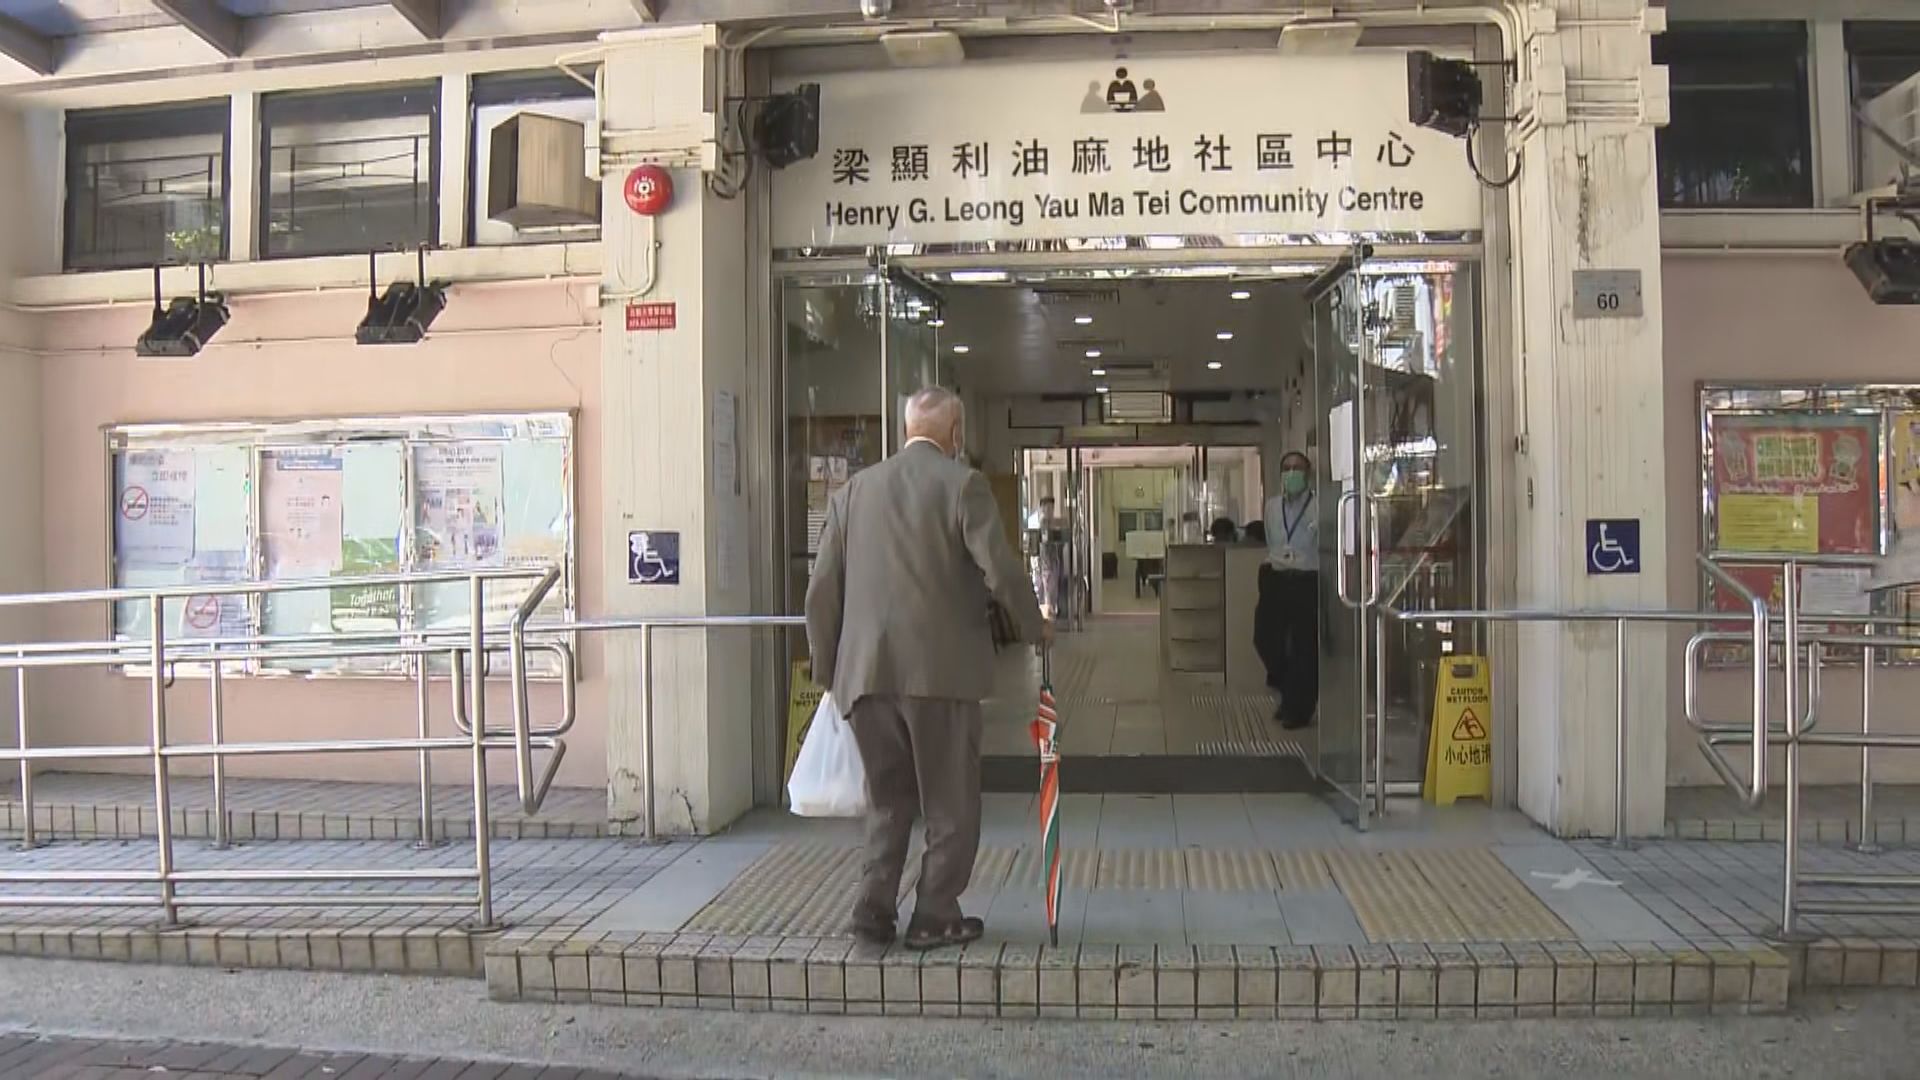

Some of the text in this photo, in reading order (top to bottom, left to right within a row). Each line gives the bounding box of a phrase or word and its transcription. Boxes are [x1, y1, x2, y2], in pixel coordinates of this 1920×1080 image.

[832, 130, 1415, 185] 梁顯利油麻地社區中心
[825, 186, 1424, 231] Henry G. Leong Yau Ma Tei Community Centre
[1597, 292, 1619, 311] 60
